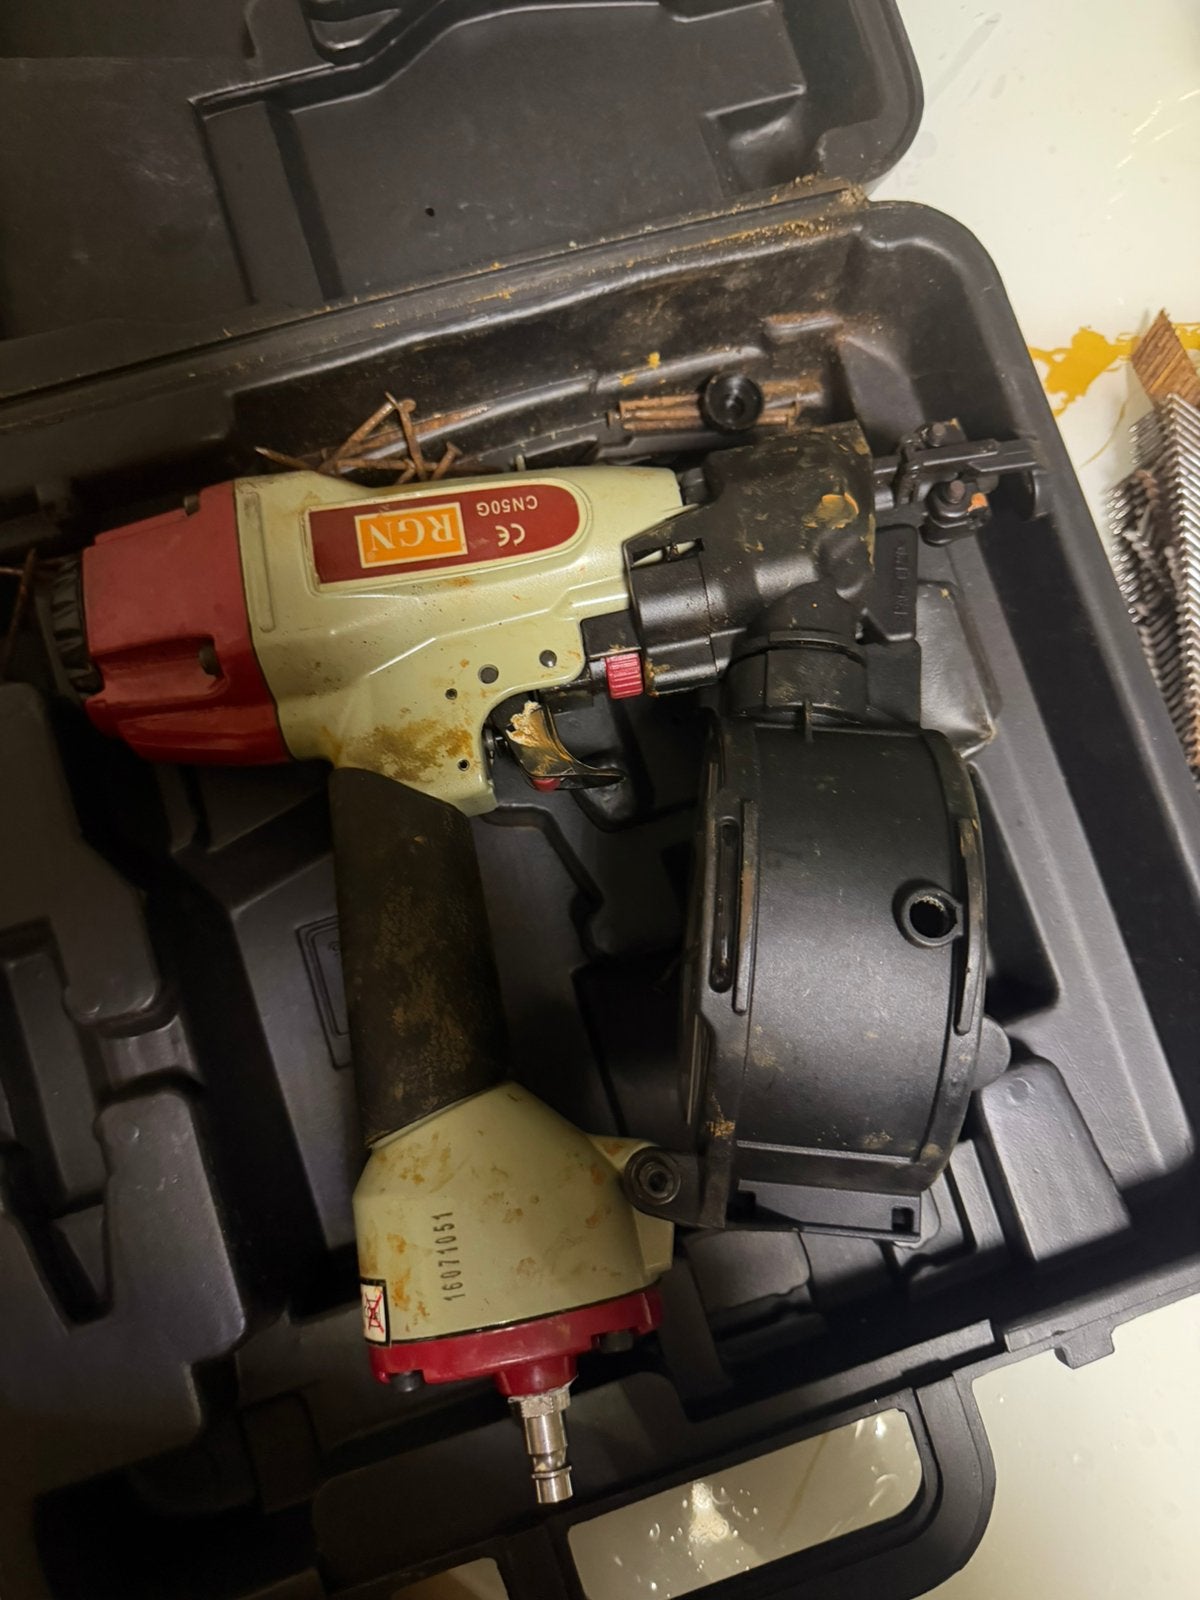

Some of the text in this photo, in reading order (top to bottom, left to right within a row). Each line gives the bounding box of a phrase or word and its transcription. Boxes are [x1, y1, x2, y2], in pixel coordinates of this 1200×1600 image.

[476, 495, 538, 517] CN50G
[369, 514, 455, 551] RGN
[495, 523, 526, 547] CE
[431, 1212, 466, 1301] 16071051
